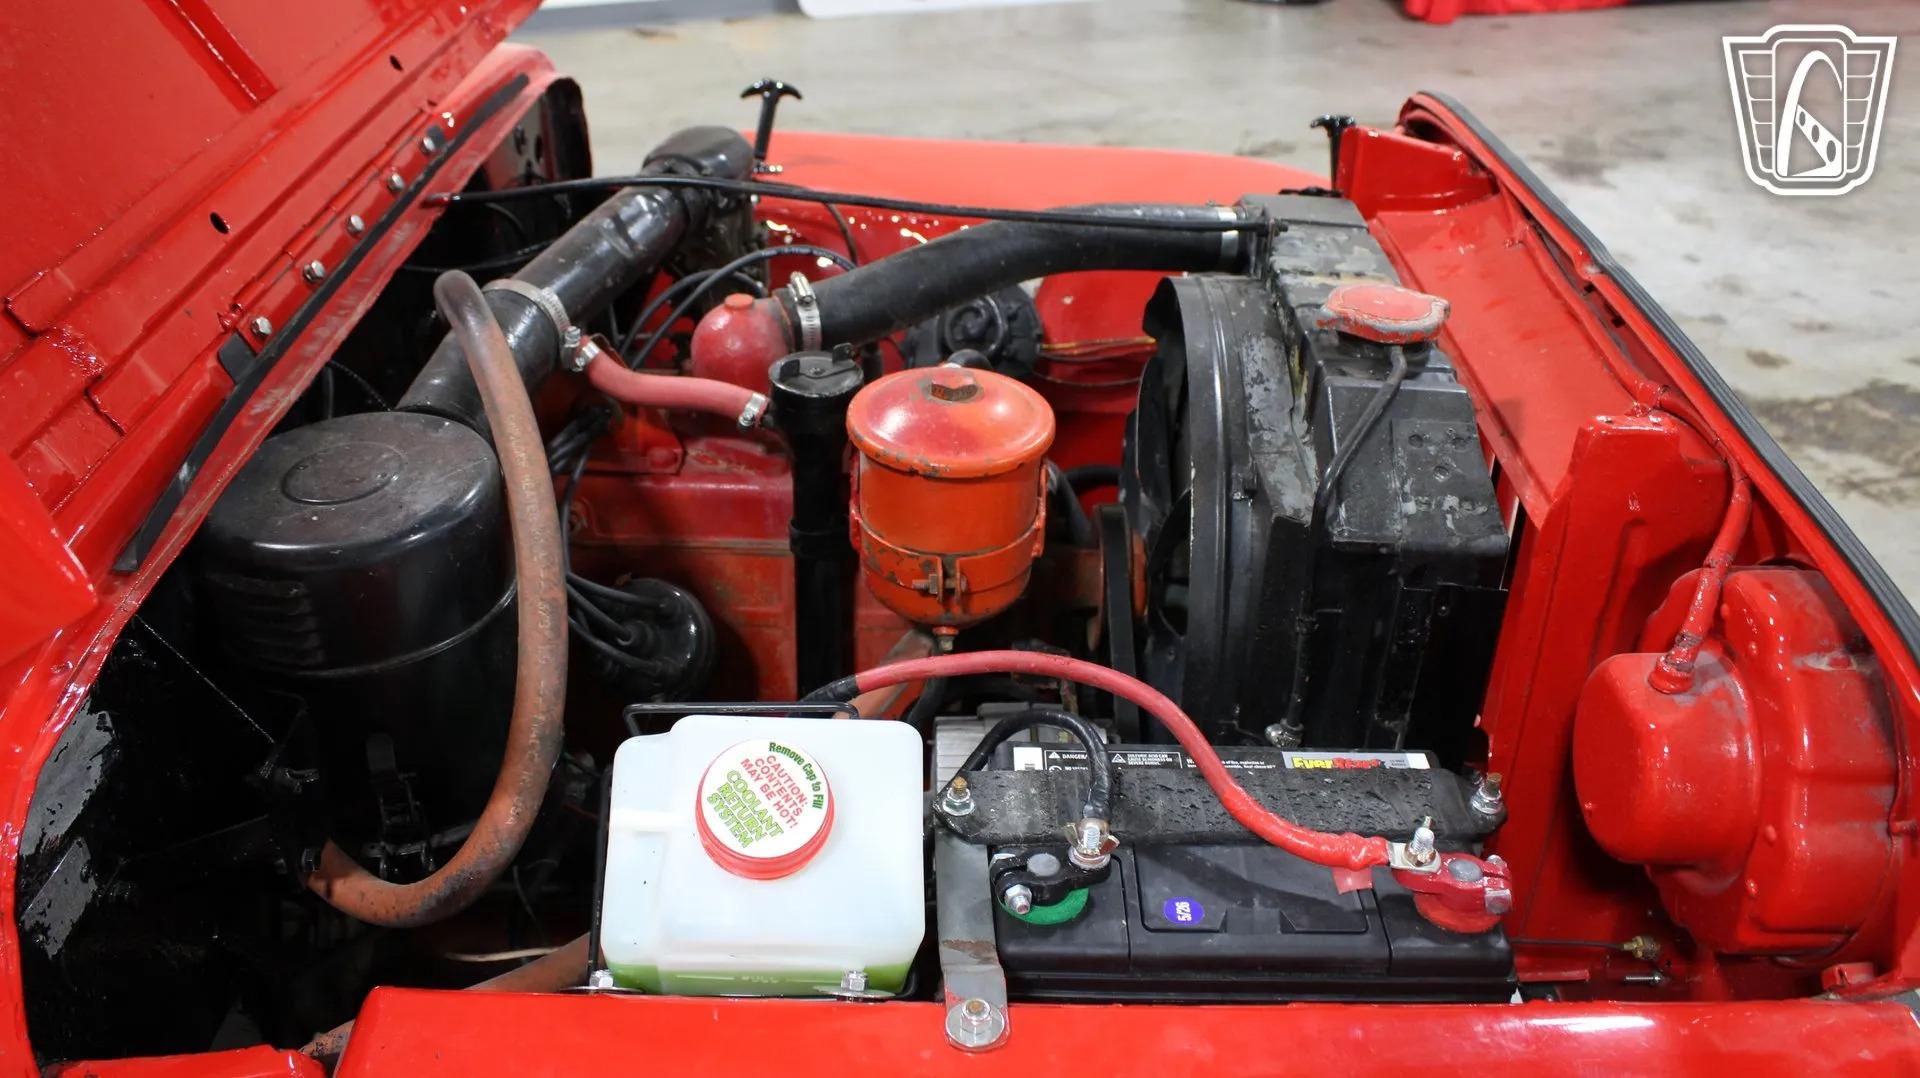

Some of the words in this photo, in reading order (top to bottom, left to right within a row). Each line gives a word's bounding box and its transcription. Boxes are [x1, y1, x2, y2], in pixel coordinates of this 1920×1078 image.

[768, 742, 805, 766] Remove
[802, 763, 817, 781] Cap
[726, 770, 784, 837] COOLANT
[740, 758, 763, 782] MAY
[760, 783, 776, 800] BE
[773, 800, 798, 829] HOT!
[755, 758, 803, 816] CONTENTS
[766, 755, 808, 807] CAUTION:
[811, 781, 821, 792] to
[812, 794, 824, 809] Fill
[707, 792, 754, 848] SYSTEM
[717, 782, 763, 841] RETURN
[1175, 901, 1192, 921] 5/26
